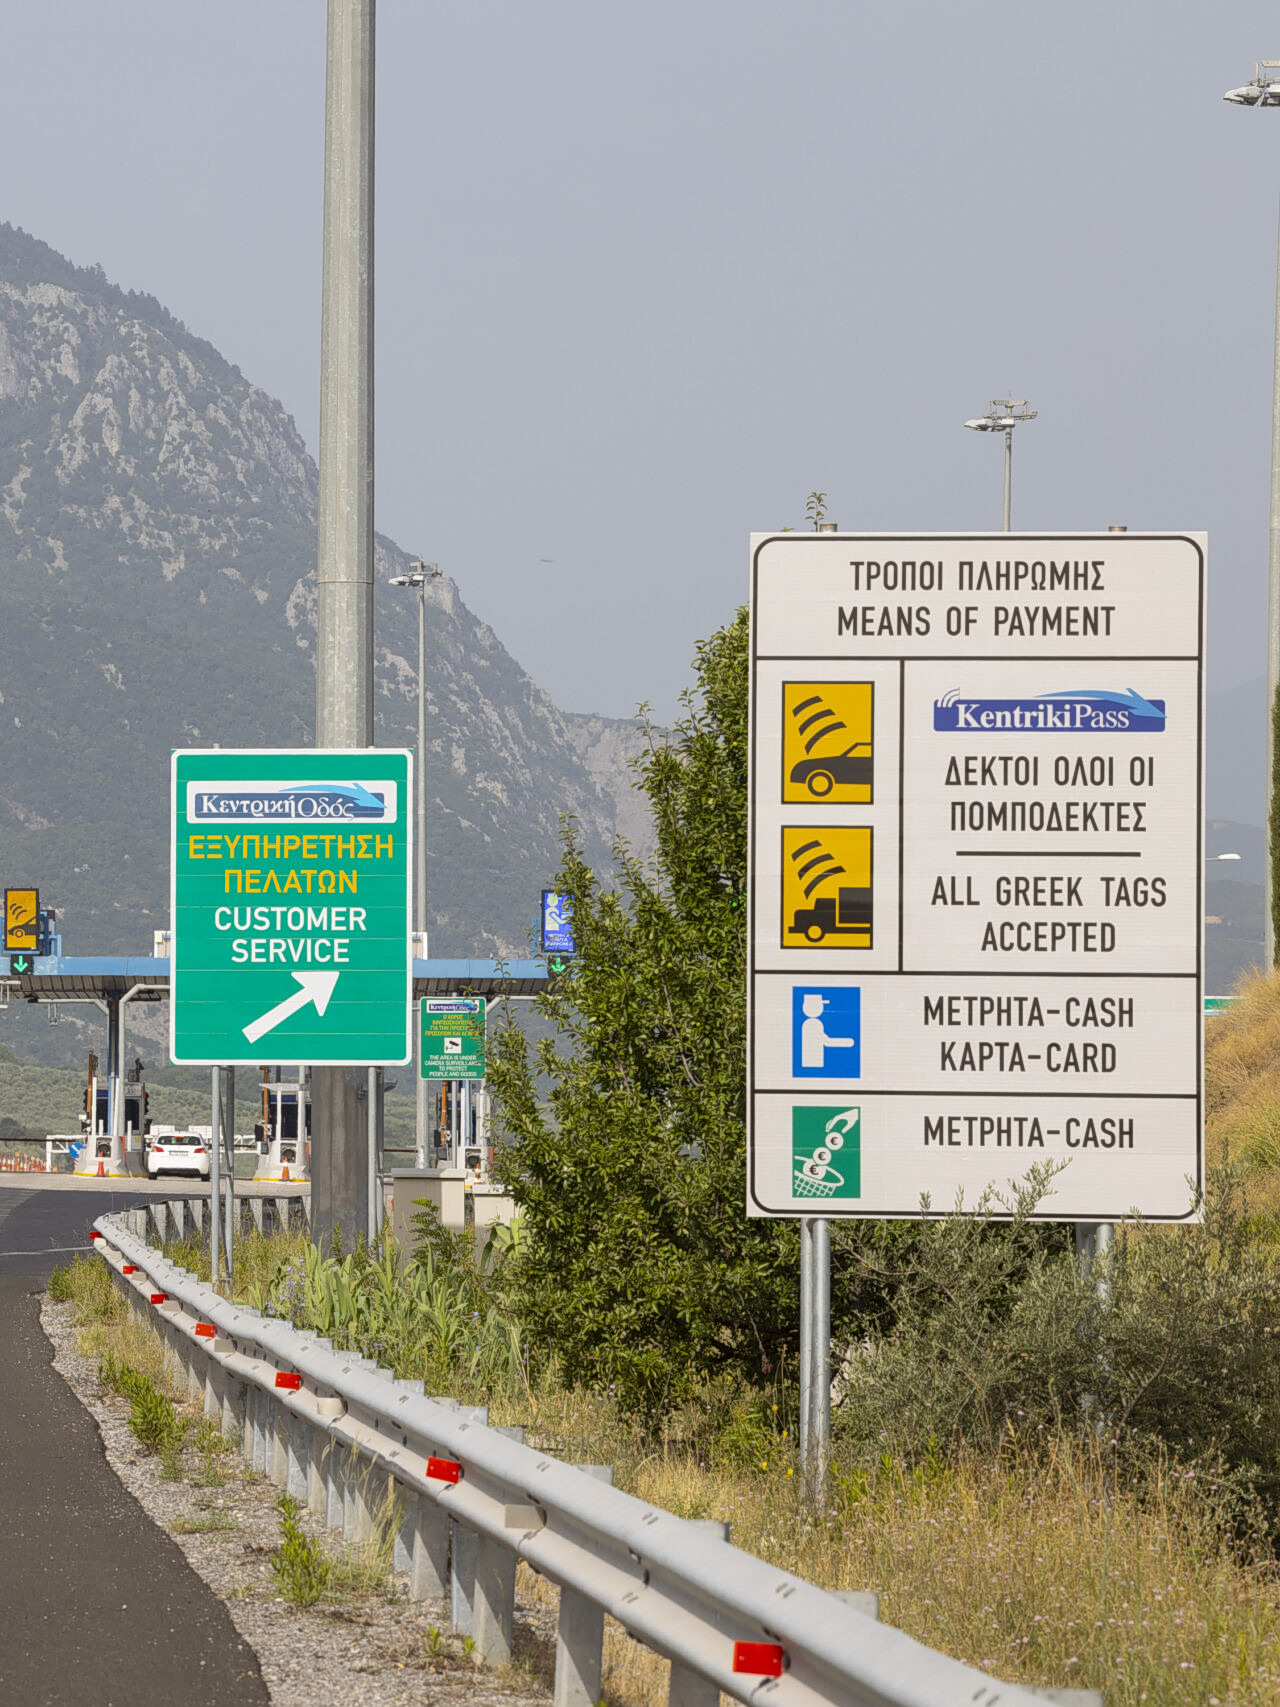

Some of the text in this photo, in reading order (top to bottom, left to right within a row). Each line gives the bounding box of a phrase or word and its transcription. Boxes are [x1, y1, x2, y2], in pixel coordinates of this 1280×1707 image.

[850, 561, 1105, 591] ΤΡΟΠΟΙ ΠΛΗΡΩΜΗΣ
[837, 607, 1116, 636] MEANS OF PAYMENT
[945, 756, 1154, 786] ΔΕΚΤΟΙ ΟΛΟΙ ΟΙ
[951, 801, 1147, 832] ΠΟΜΠΟΔΕΚΤΕΣ
[189, 834, 394, 859] ΕΞΥΠΗΡΕΤΗΣΗ
[224, 869, 358, 894] ΠΕΛΑΤΩΝ
[931, 876, 1167, 907] ALL GREEK TAGS
[214, 906, 367, 931] CUSTOMER
[231, 938, 350, 963] SERVICE
[981, 922, 1116, 952] ACCEPTED
